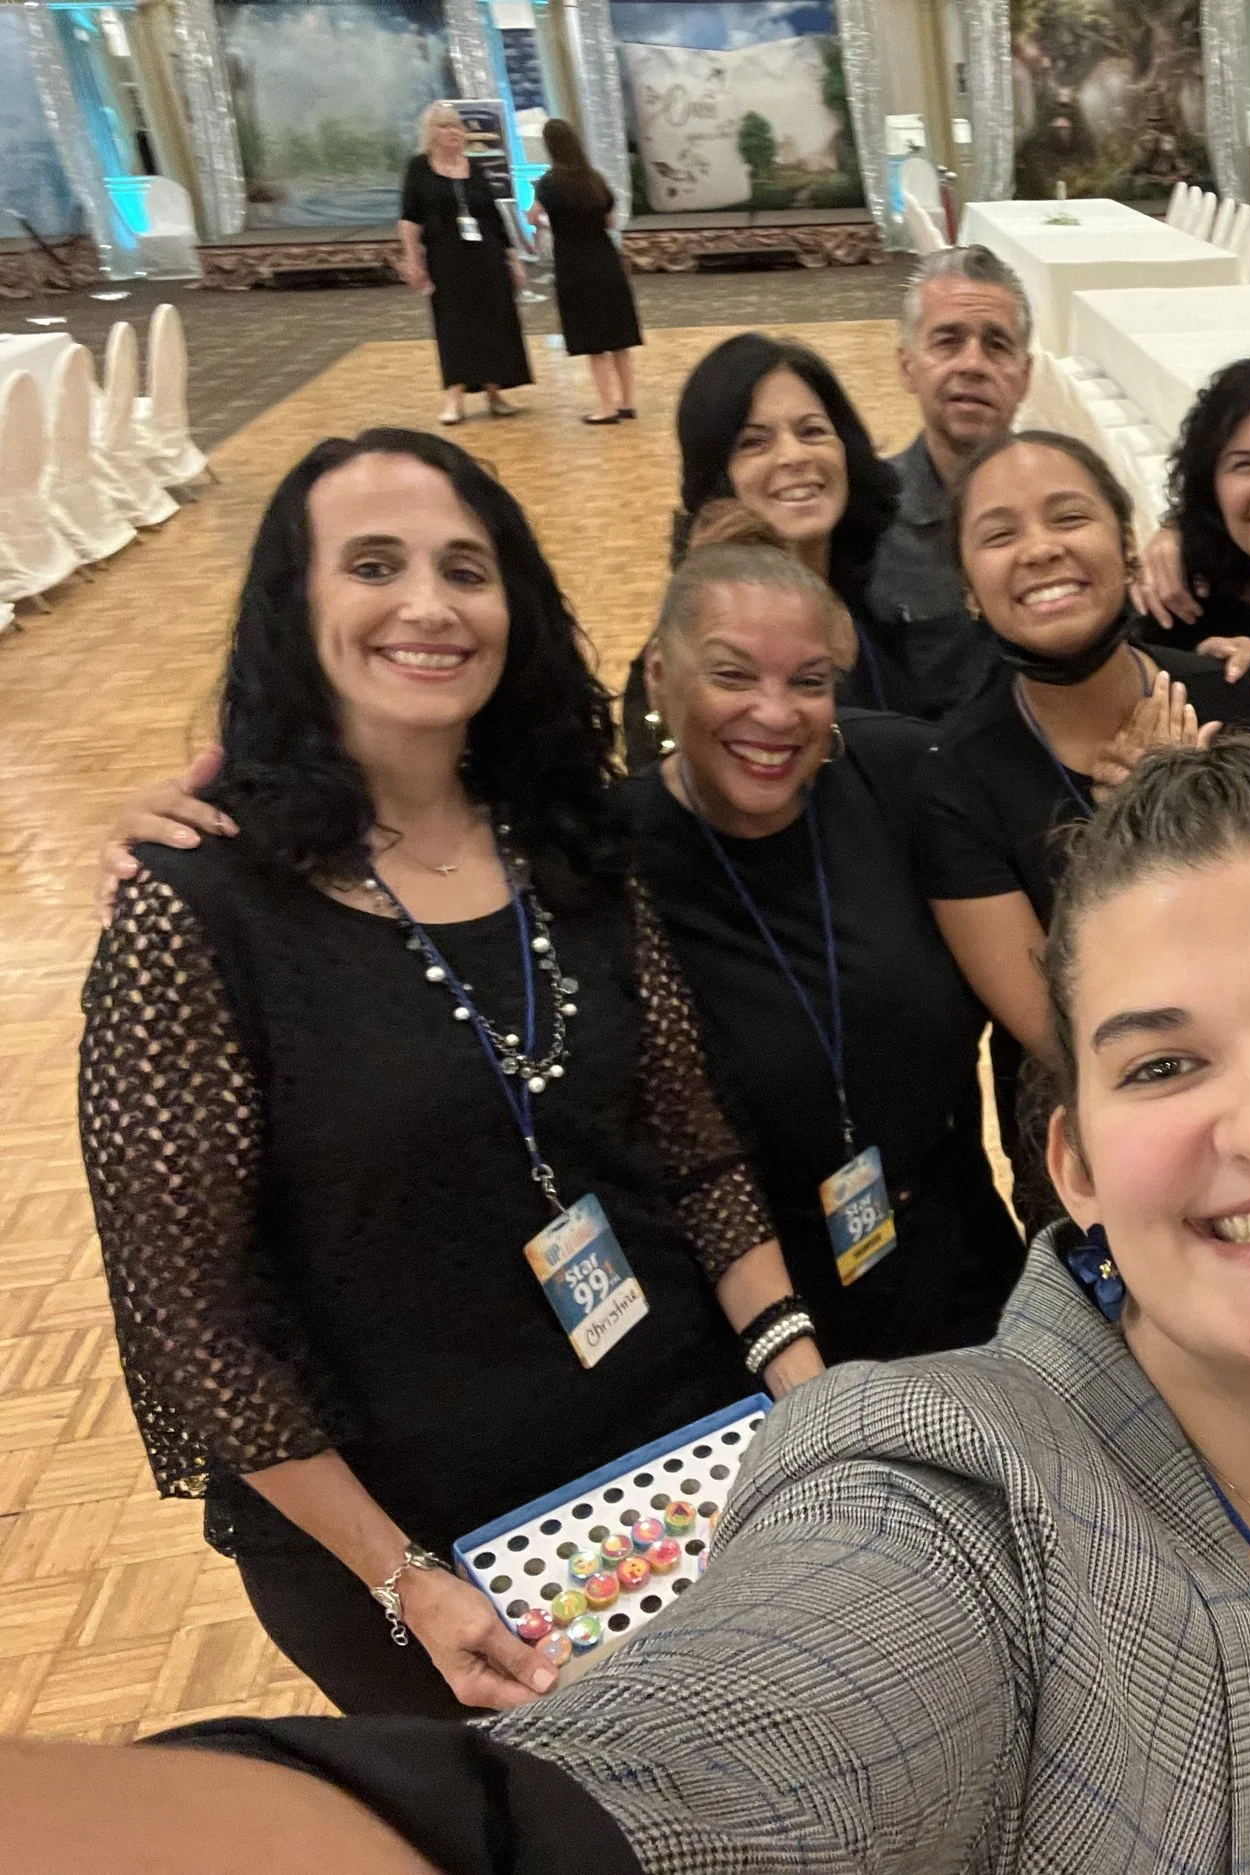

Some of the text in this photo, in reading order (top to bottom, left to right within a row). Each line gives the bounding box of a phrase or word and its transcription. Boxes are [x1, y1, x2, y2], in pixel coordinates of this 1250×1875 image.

[848, 1207, 877, 1242] 99
[565, 1252, 599, 1289] Star
[573, 1268, 610, 1314] 99
[586, 1289, 638, 1347] Christine
